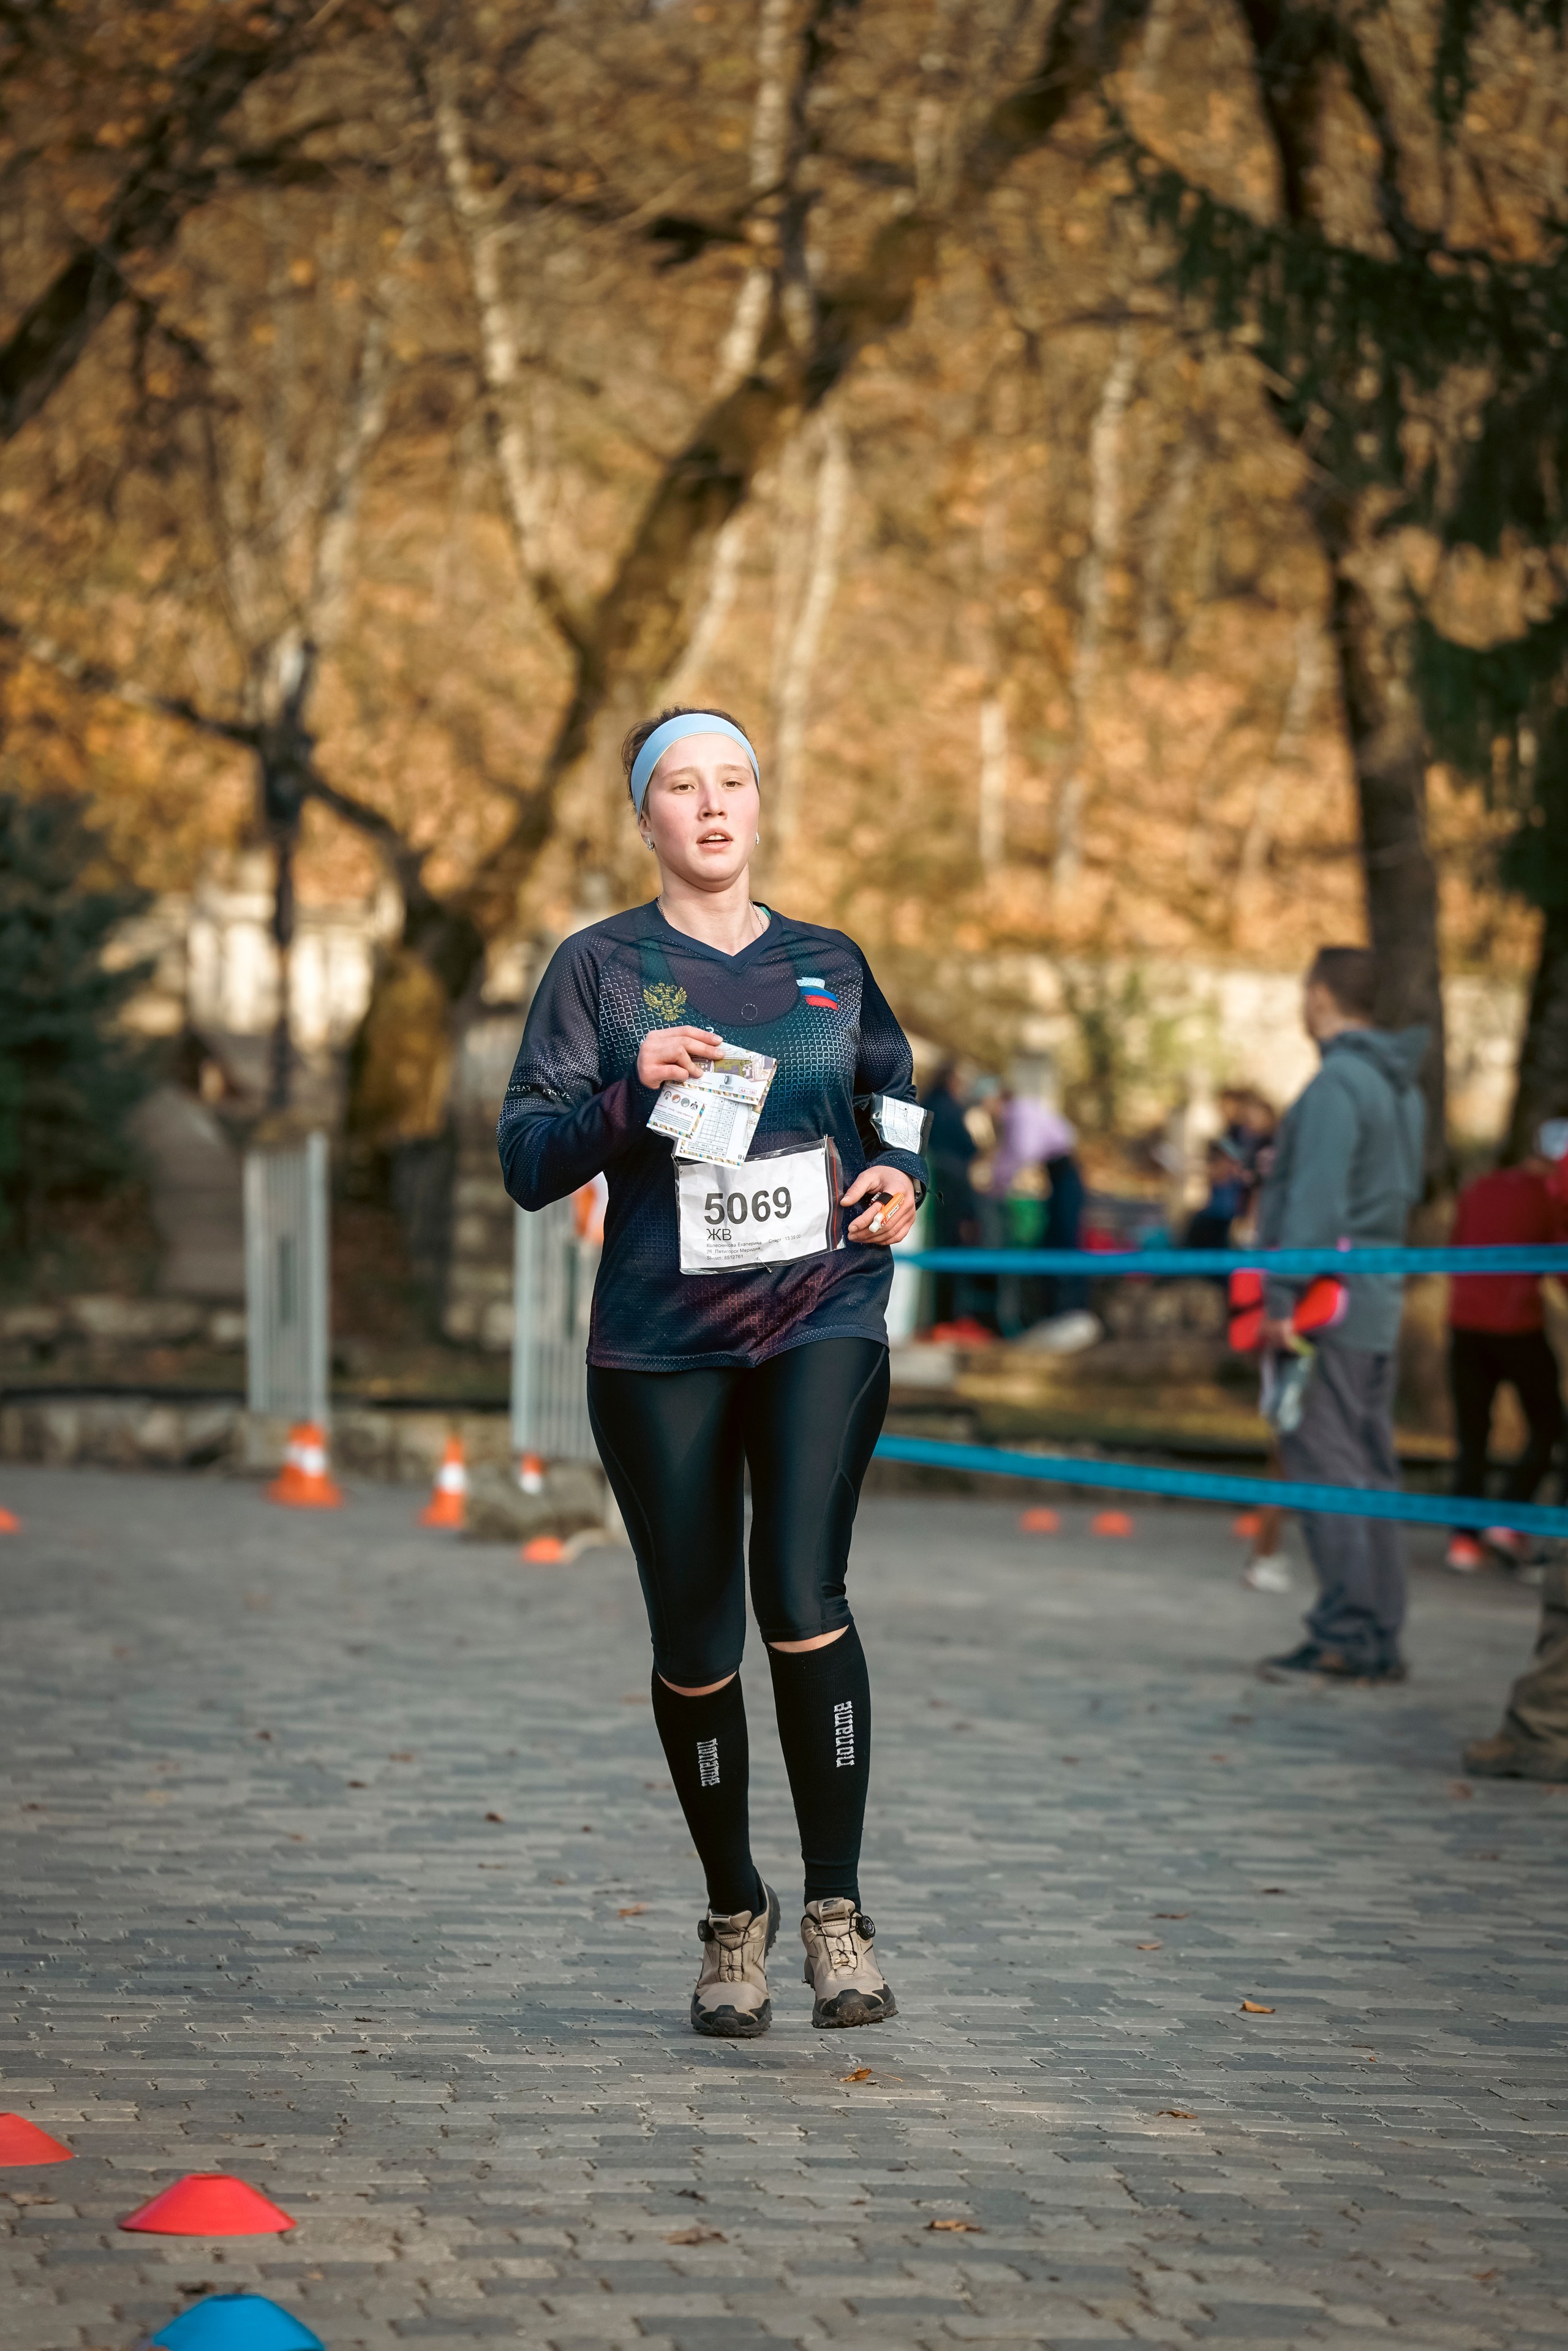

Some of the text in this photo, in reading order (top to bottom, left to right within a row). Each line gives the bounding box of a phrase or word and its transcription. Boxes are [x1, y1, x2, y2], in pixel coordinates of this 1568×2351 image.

[704, 1187, 792, 1225] 5069
[706, 1228, 732, 1241] ЖВ
[834, 1700, 855, 1768] noname
[696, 1738, 720, 1787] noname
